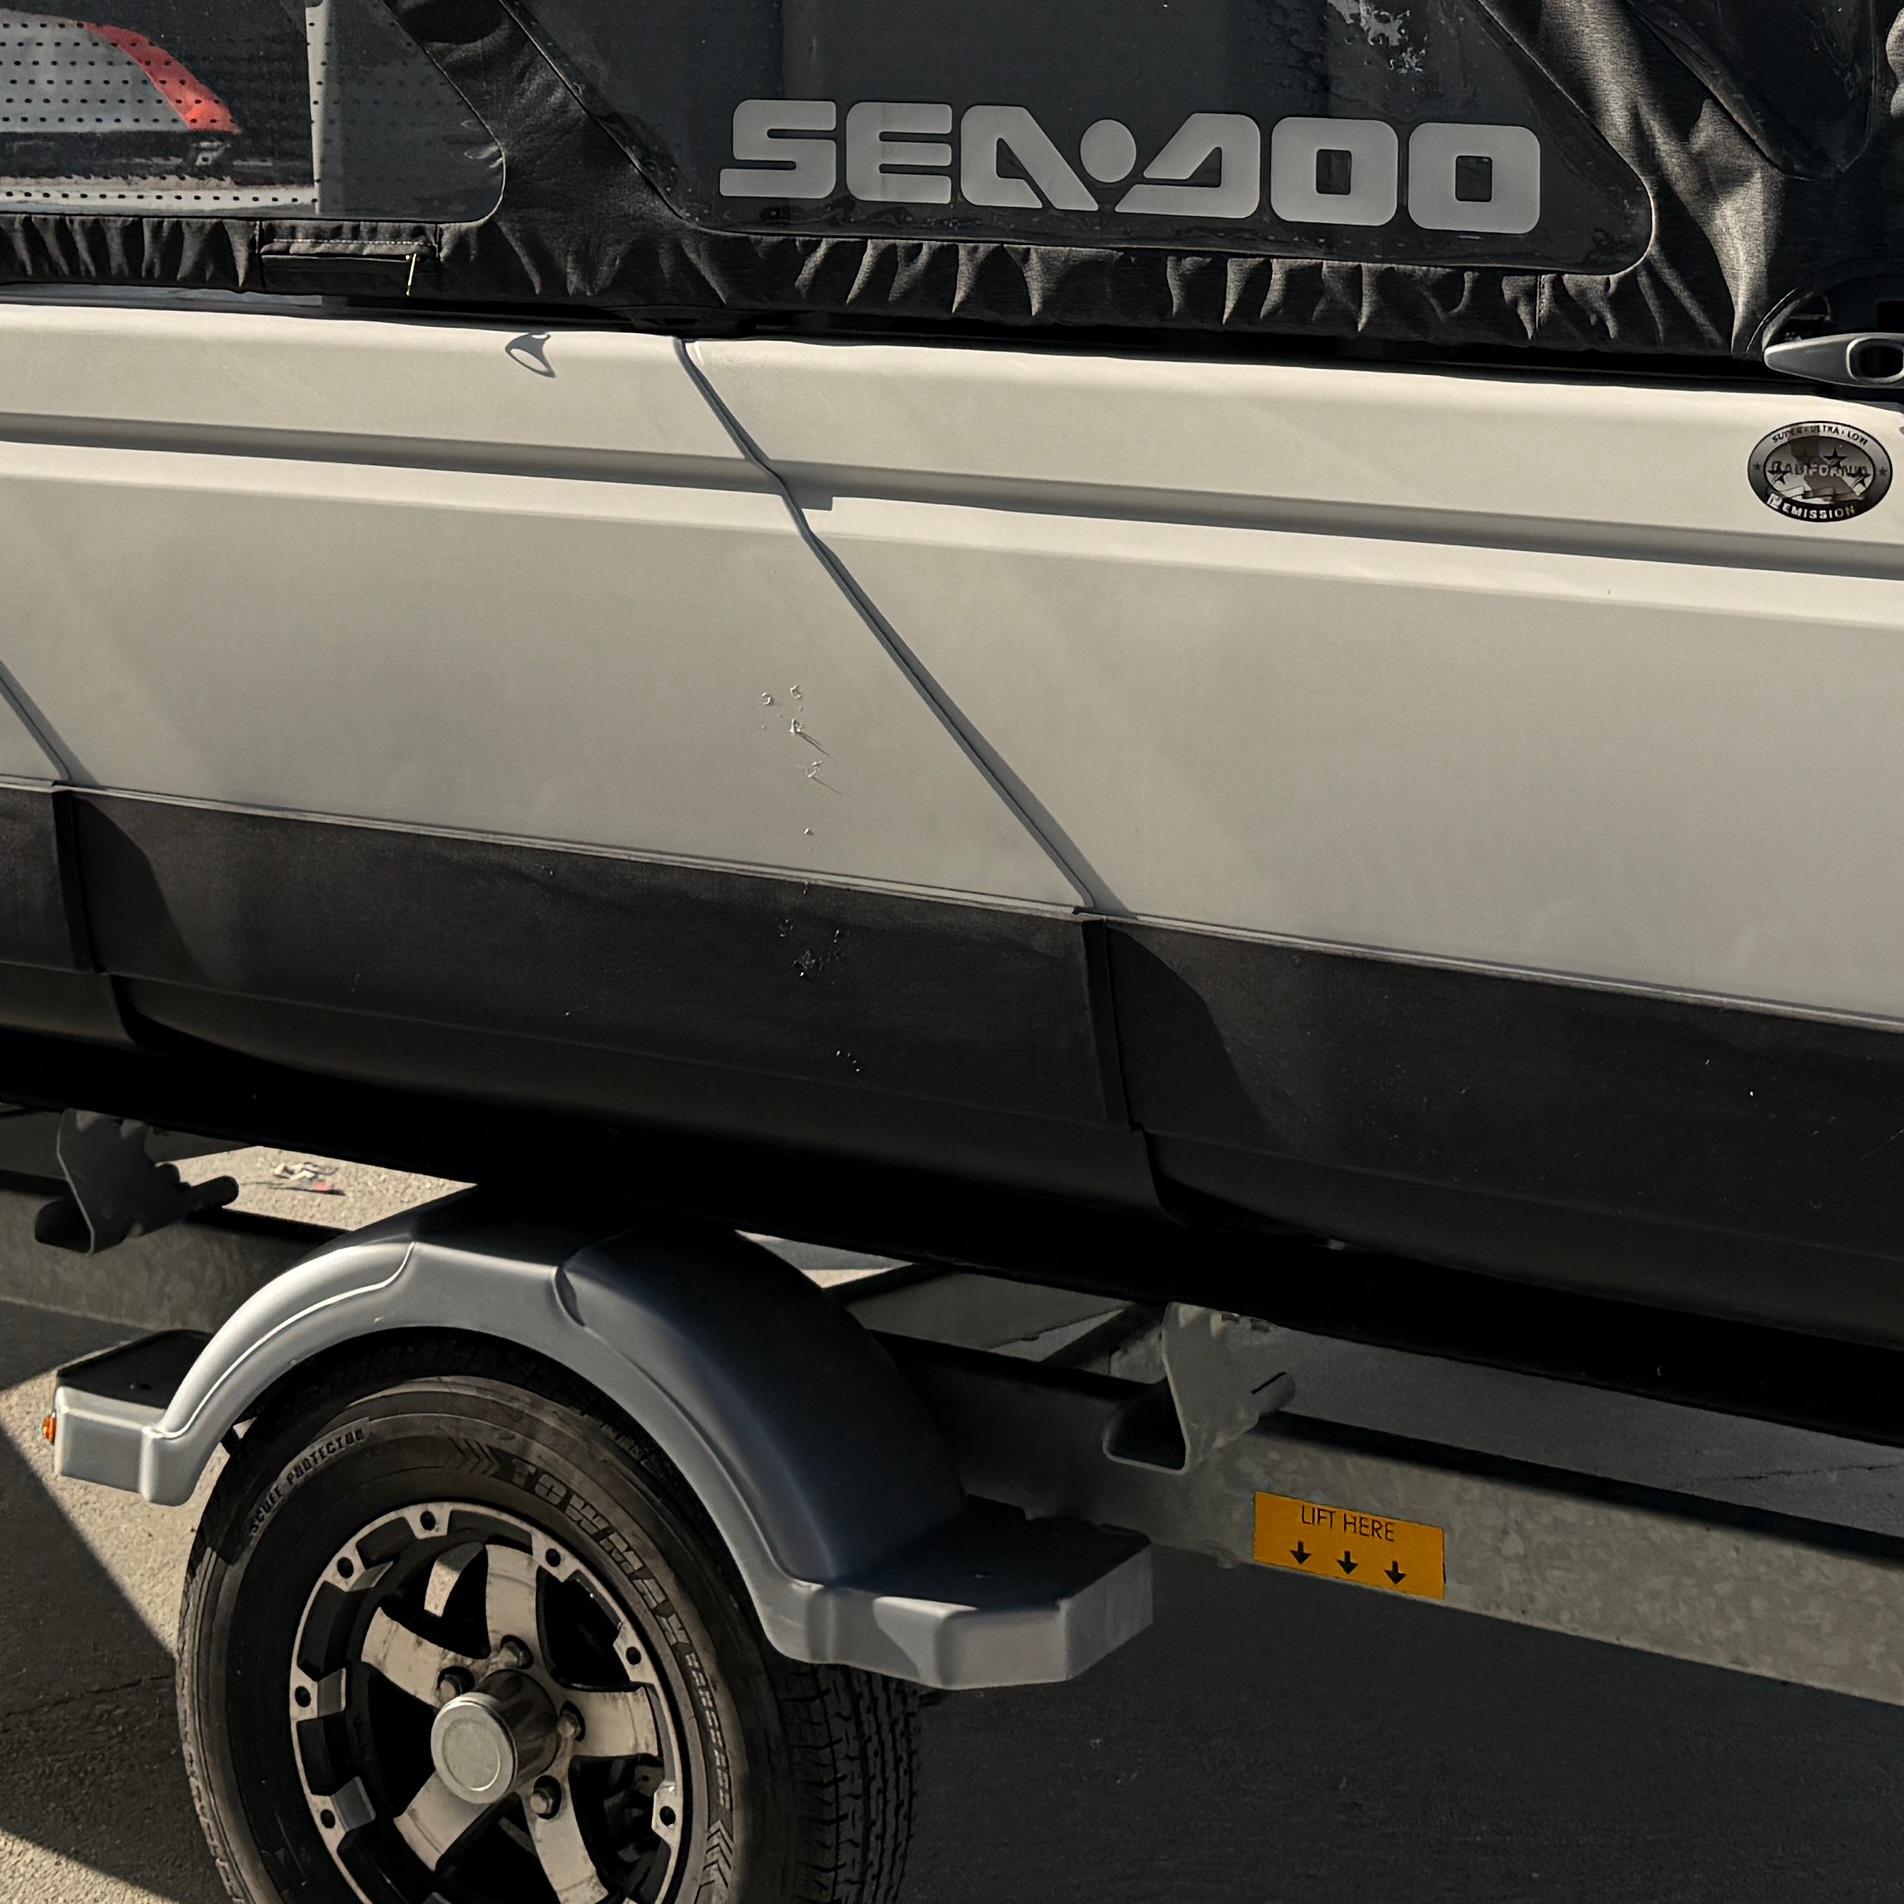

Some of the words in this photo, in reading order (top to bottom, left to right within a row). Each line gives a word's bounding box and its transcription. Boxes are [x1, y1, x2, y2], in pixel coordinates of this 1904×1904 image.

[1782, 502, 1856, 520] EMISSION
[1301, 1504, 1337, 1530] LIFT
[1343, 1511, 1396, 1543] HERE
[512, 1458, 692, 1646] TOWMAX
